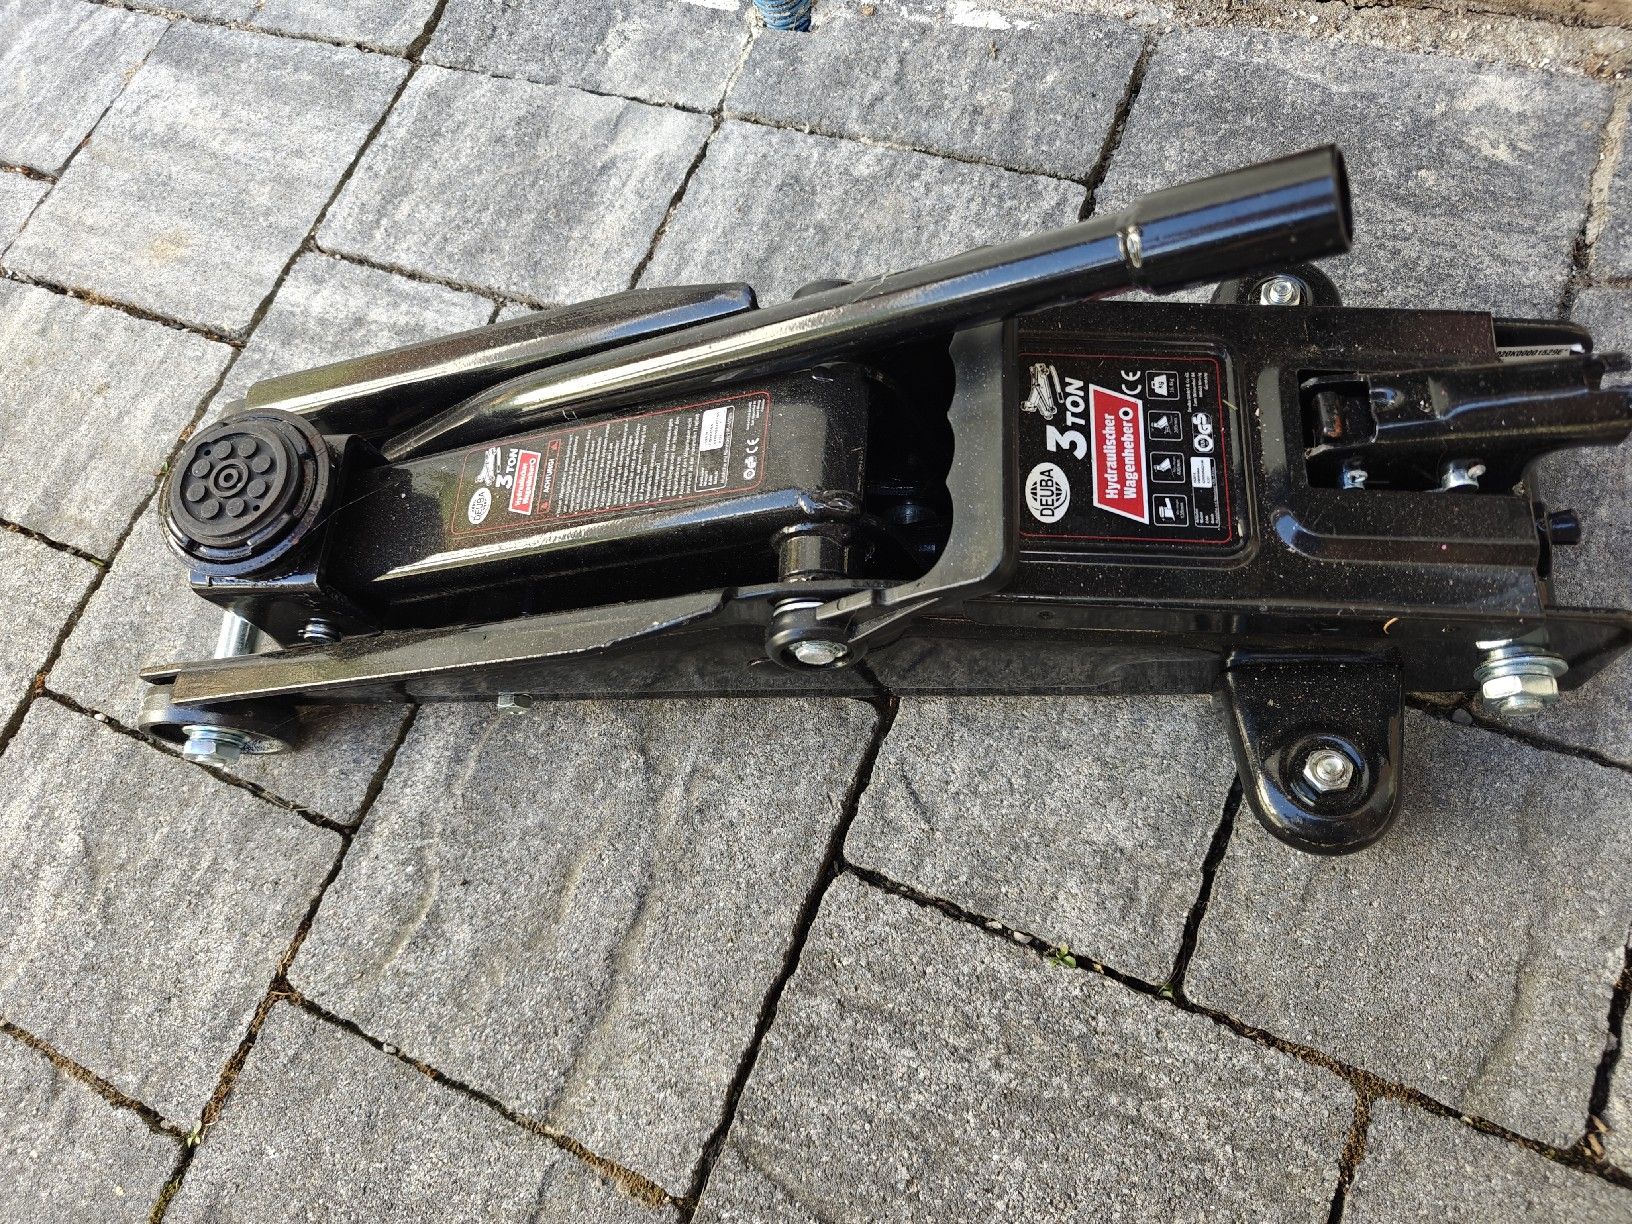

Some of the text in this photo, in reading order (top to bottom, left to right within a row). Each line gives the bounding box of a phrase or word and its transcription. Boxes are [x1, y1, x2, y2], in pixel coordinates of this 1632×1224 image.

[1046, 377, 1087, 460] 3 TON
[1102, 413, 1120, 499] Hydraulischer
[495, 448, 519, 489] 3 TON
[1039, 469, 1055, 517] DEUBA
[1121, 421, 1138, 499] Wagenheber
